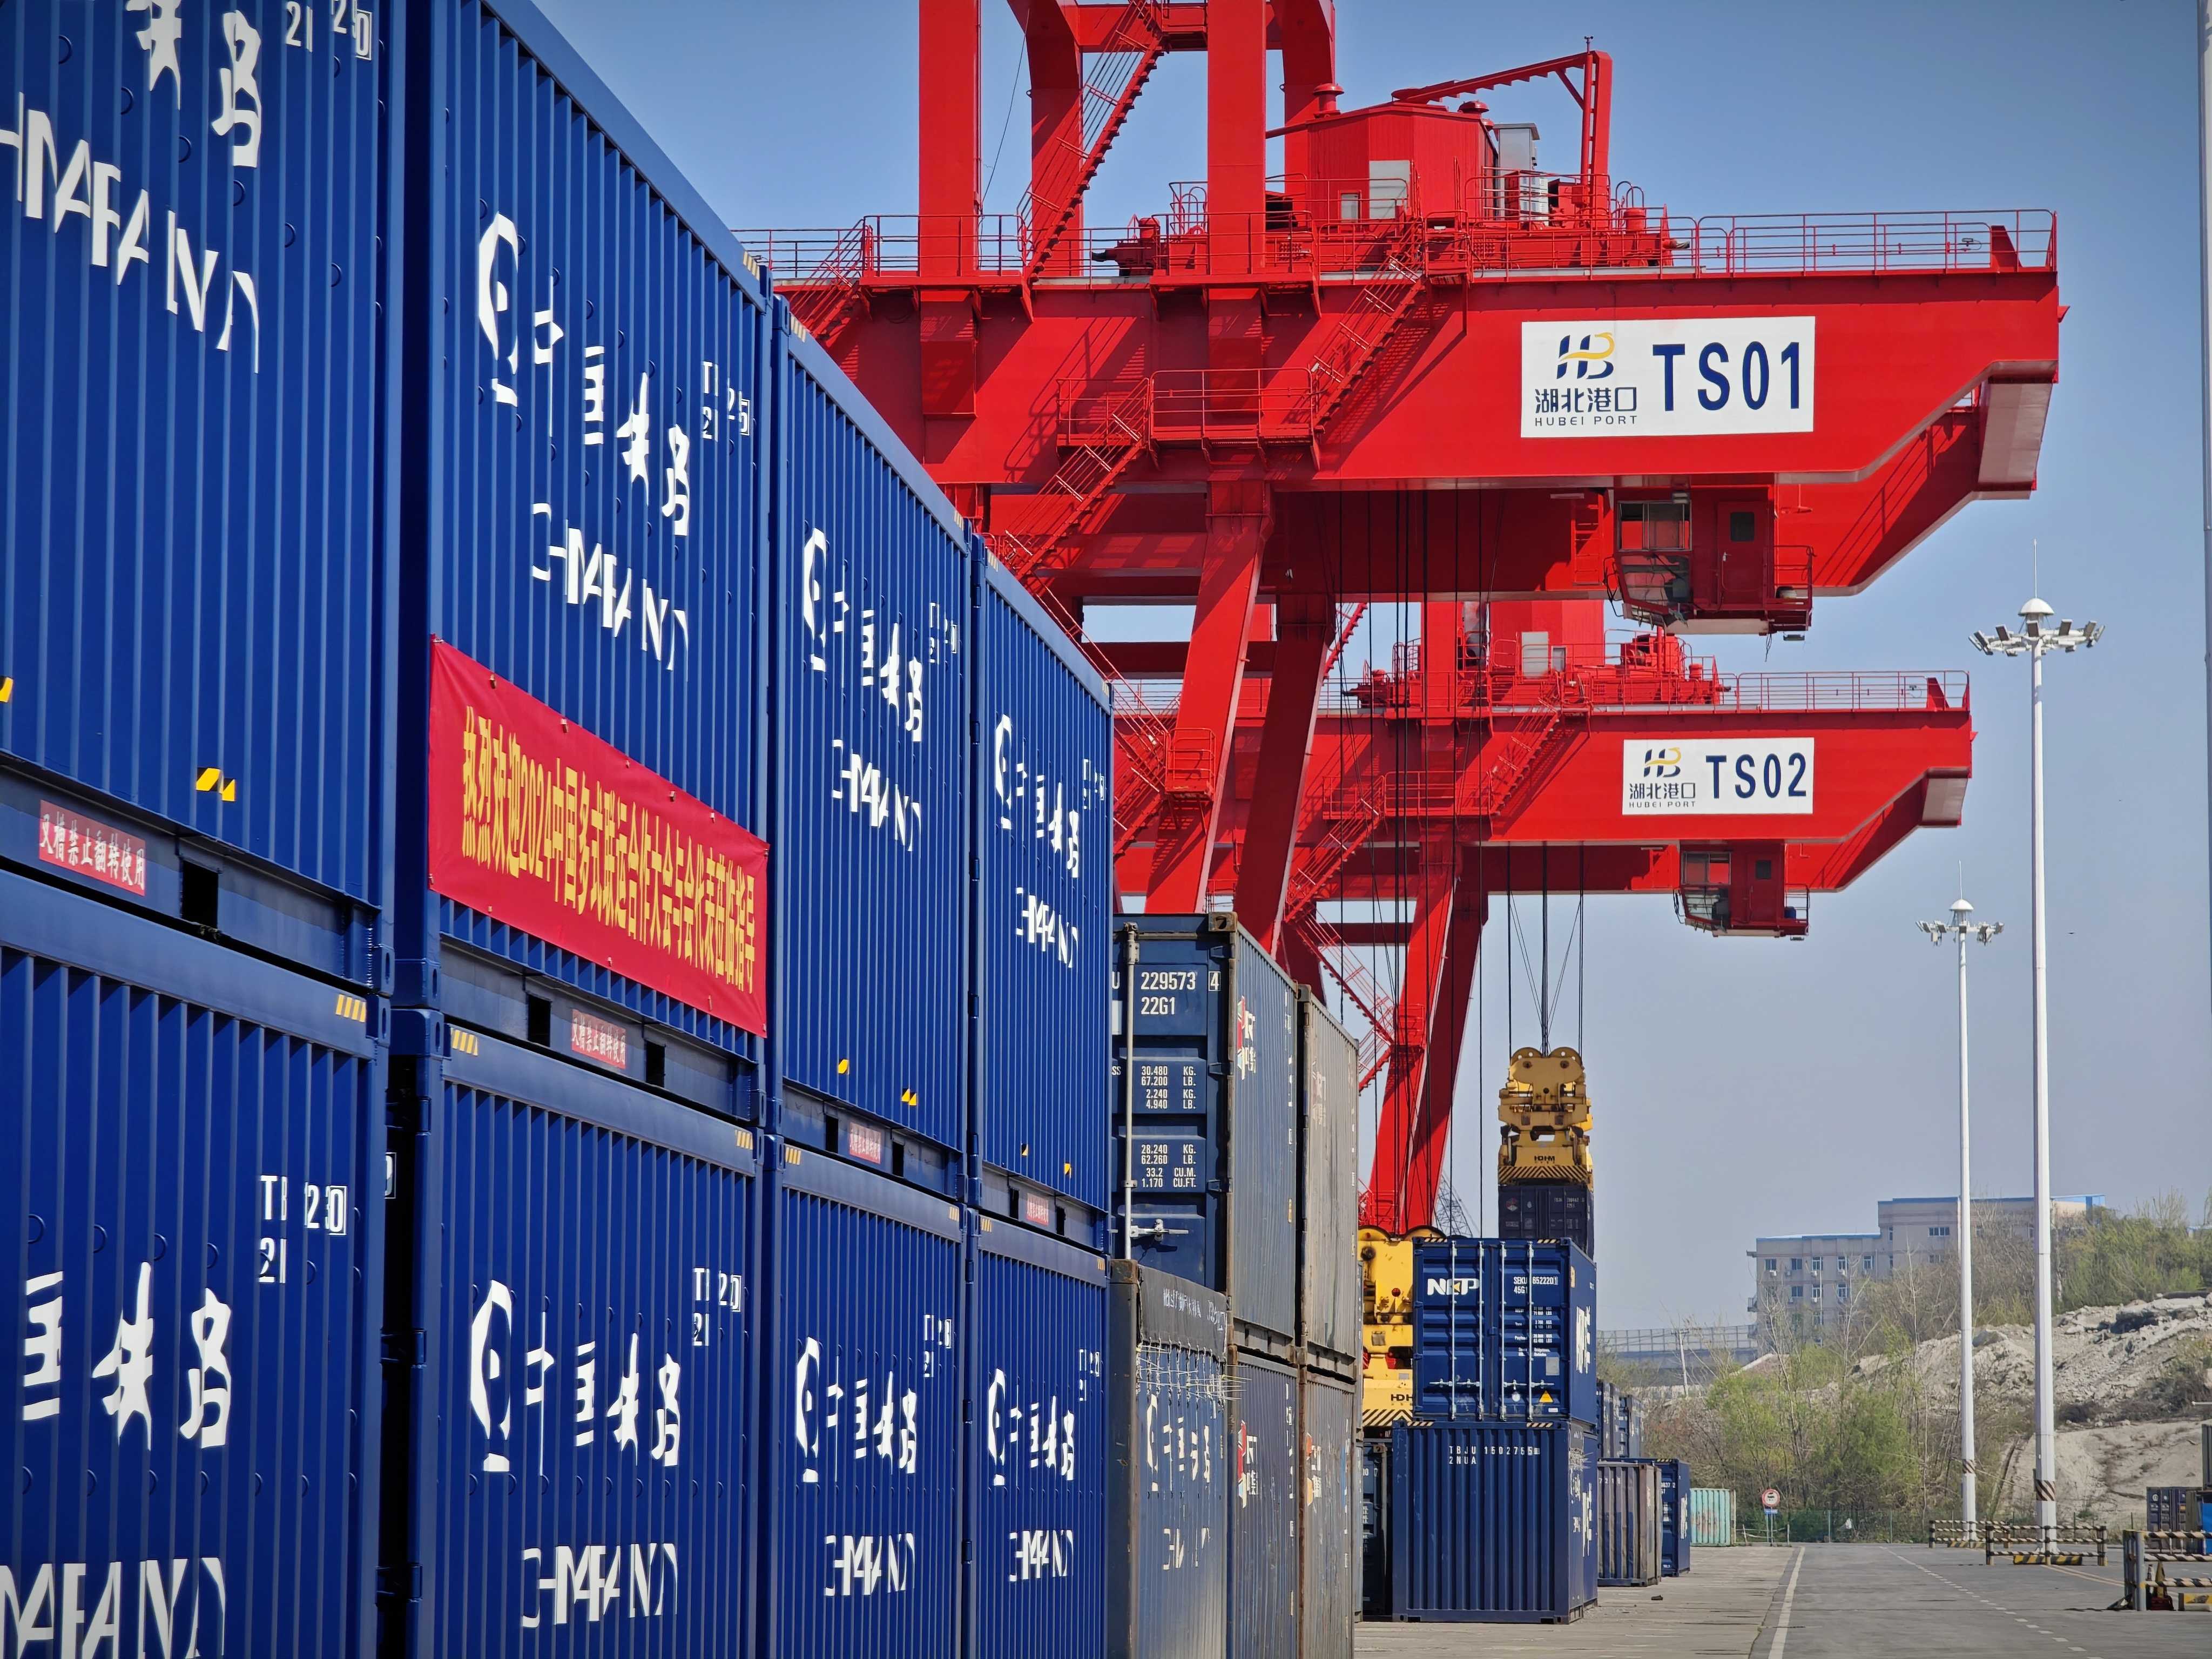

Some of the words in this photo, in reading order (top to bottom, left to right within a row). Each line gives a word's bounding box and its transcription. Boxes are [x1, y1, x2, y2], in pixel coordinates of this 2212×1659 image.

[1653, 341, 1799, 412] TS01
[1535, 387, 1637, 414] 湖北港口
[1535, 416, 1585, 427] HUBEI
[1594, 415, 1637, 425] PORT
[1705, 752, 1806, 799] TS02
[1629, 783, 1696, 799] 湖北港口
[462, 706, 755, 994] 热烈欢迎2024中国多式联运合作大会与会代表莅临指导
[1141, 971, 1196, 990] 229573
[1210, 974, 1219, 989] 4
[1141, 996, 1175, 1015] 22G1
[1183, 1066, 1196, 1076] KG.
[1183, 1076, 1196, 1086] LB.
[1183, 1089, 1196, 1099] KG.
[1183, 1099, 1196, 1109] LB.
[1183, 1144, 1196, 1154] KG.
[1183, 1155, 1196, 1164] LB.
[1174, 1167, 1196, 1177] CU.M.
[1173, 1177, 1196, 1188] CU.FT.
[1449, 1445, 1476, 1454] TBJU
